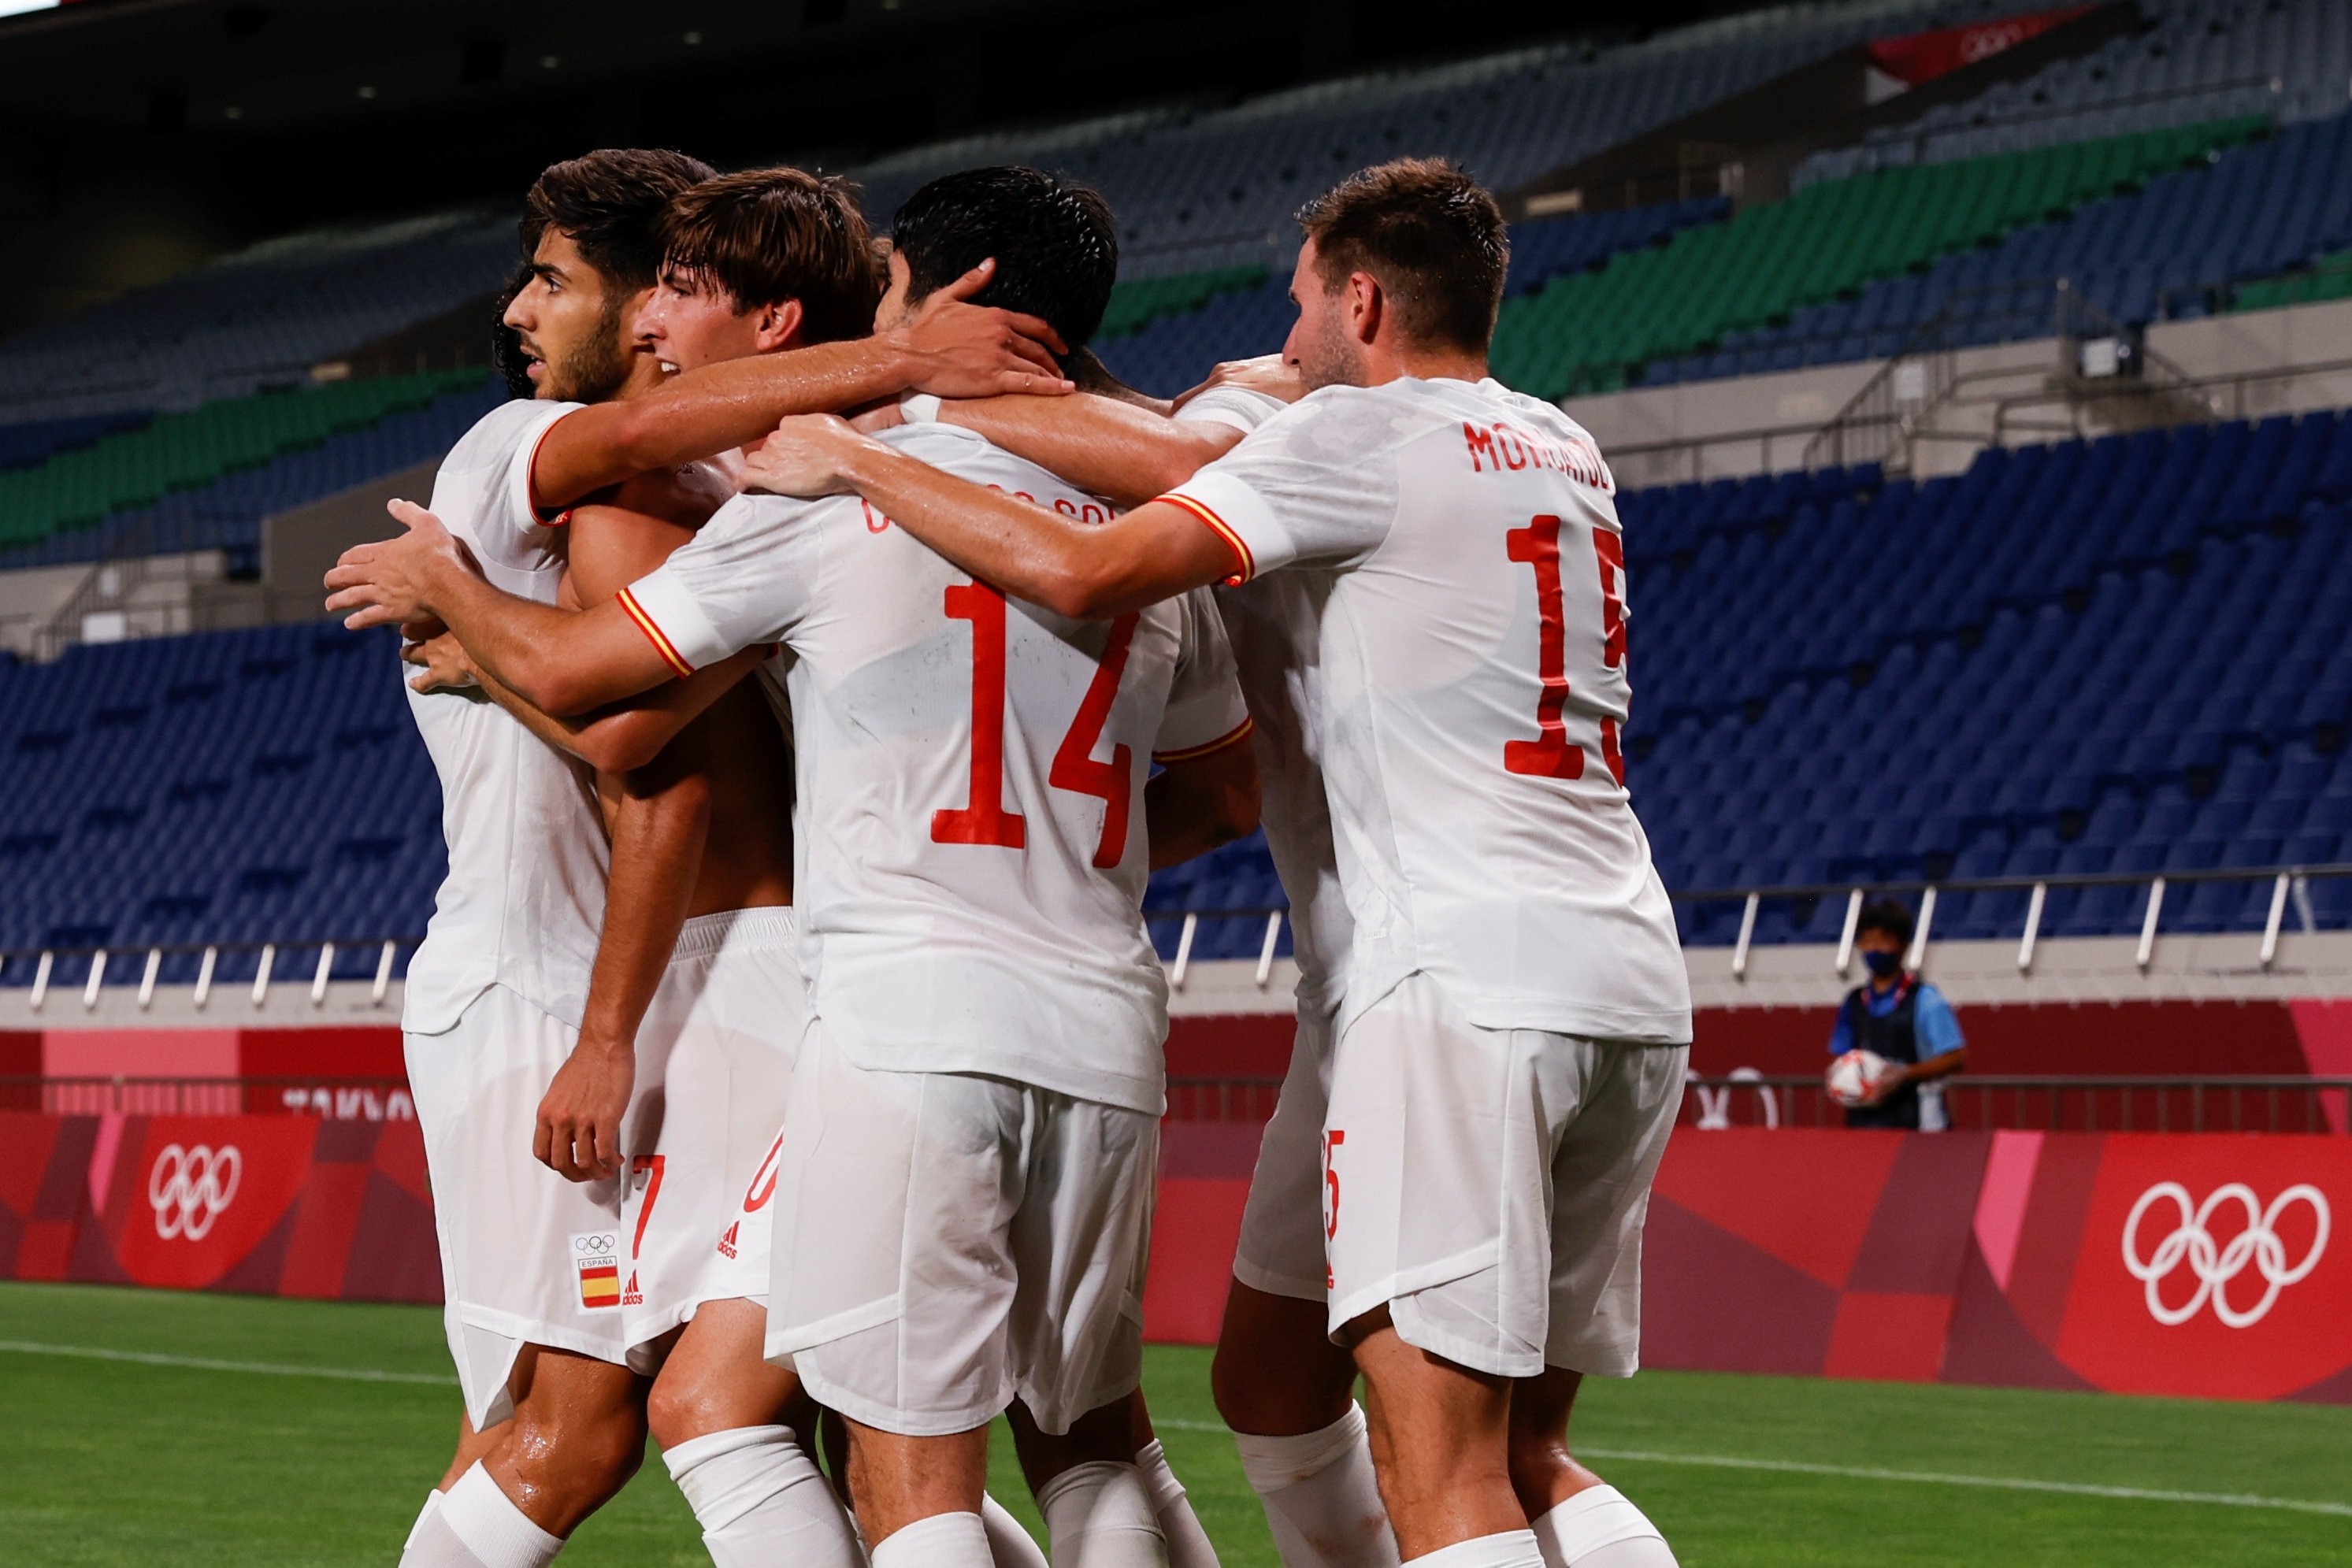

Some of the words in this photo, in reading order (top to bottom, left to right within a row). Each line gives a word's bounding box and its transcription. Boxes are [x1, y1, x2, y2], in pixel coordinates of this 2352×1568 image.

[930, 577, 1141, 869] 14
[1504, 514, 1629, 788] 15
[581, 1258, 614, 1267] ESPAÑA
[633, 1155, 666, 1260] 7
